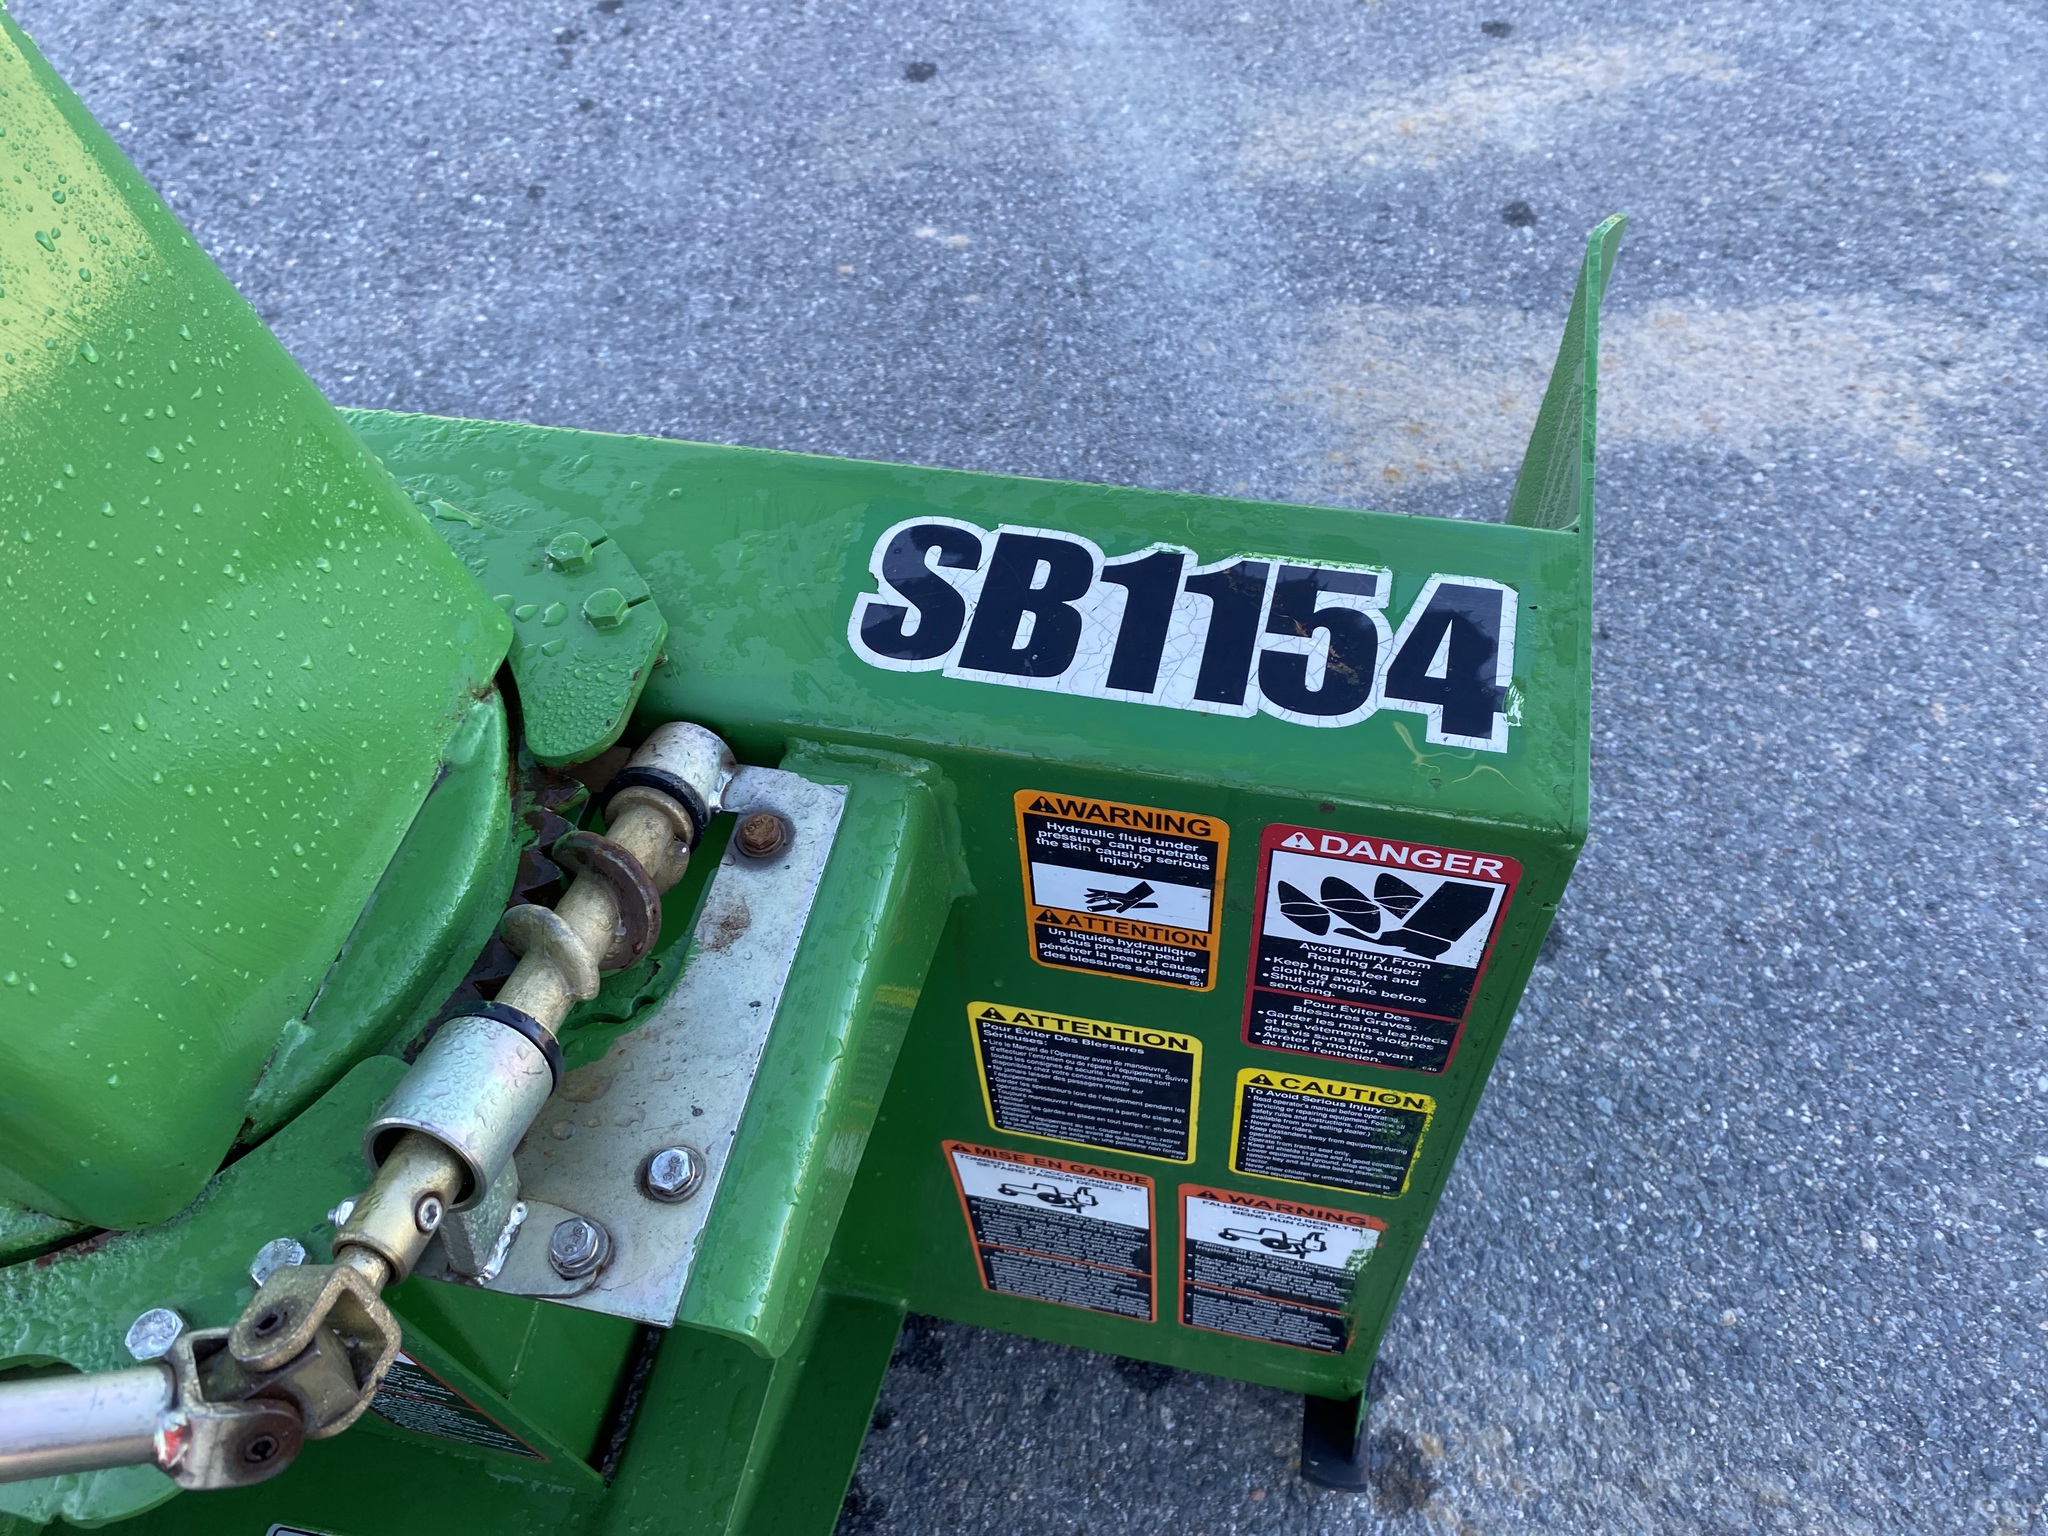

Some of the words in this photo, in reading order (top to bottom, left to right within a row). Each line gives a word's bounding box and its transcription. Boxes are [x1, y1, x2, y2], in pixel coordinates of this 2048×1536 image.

[859, 523, 1509, 742] SB1154
[1056, 798, 1211, 837] WARNING
[1038, 831, 1101, 846] pressure
[1108, 842, 1134, 850] can
[1138, 845, 1208, 863] penetrate
[1046, 821, 1114, 840] Hydraulic
[1118, 833, 1151, 844] fluid
[1155, 838, 1198, 851] under
[1035, 837, 1058, 847] the
[1061, 841, 1091, 852] skin
[1095, 846, 1151, 863] causing
[1155, 856, 1210, 870] serious
[1099, 855, 1143, 869] injury.
[1319, 835, 1505, 878] DANGER
[1048, 927, 1066, 936] Un
[1069, 931, 1114, 945] liquide
[1117, 938, 1196, 958] hydraulique
[1065, 914, 1207, 947] ATTENTION
[1039, 941, 1092, 956] pénétrer
[1110, 954, 1142, 964] peau
[1145, 958, 1158, 966] et
[1161, 962, 1206, 973] causer
[1043, 950, 1066, 959] des
[1069, 954, 1131, 969] blessures
[1135, 964, 1200, 980] sérieuses.
[1059, 938, 1091, 947] sous
[1094, 942, 1151, 958] pression
[1155, 952, 1184, 963] peut
[1299, 943, 1341, 955] Avoid
[1344, 950, 1388, 964] Injury
[1391, 957, 1431, 969] From
[1306, 953, 1368, 969] Rotating
[1371, 962, 1422, 977] Auger:
[1271, 965, 1329, 981] clothing
[1332, 975, 1373, 988] away.
[1273, 956, 1309, 970] Keep
[1391, 975, 1420, 986] and
[1269, 980, 1335, 997] servicing.
[1270, 972, 1302, 983] Shut
[1305, 978, 1325, 987] off
[1328, 981, 1377, 997] engine
[1380, 990, 1427, 1003] before
[1303, 999, 1336, 1010] Pour
[1383, 1012, 1410, 1022] Des
[1363, 1017, 1417, 1031] Graves:
[1010, 1011, 1188, 1050] ATTENTION
[1263, 1024, 1288, 1033] des
[1290, 1029, 1310, 1037] vis
[1348, 1038, 1370, 1047] fin.
[1265, 1010, 1312, 1023] Garder
[1315, 1018, 1335, 1026] les
[1338, 1022, 1383, 1035] mains,
[1386, 1029, 1407, 1038] les
[1409, 1033, 1448, 1046] pieds
[1281, 1020, 1300, 1028] les
[1303, 1023, 1373, 1040] vêtements
[1375, 1035, 1434, 1051] éloignés
[1261, 1038, 1277, 1046] de
[1281, 1042, 1310, 1051] faire
[1313, 1047, 1382, 1063] l'entretien.
[1262, 1031, 1308, 1044] Arrêter
[1326, 1042, 1374, 1054] moteur
[1376, 1050, 1413, 1061] avant
[1279, 1077, 1425, 1109] CAUTION
[975, 1147, 1026, 1163] MISE
[1033, 1157, 1062, 1169] EN
[1069, 1164, 1147, 1184] GARDE
[1202, 1200, 1249, 1212] FALLING
[1304, 1218, 1348, 1229] RESULT
[1228, 1194, 1367, 1225] WARNING
[1232, 1210, 1267, 1220] BEING
[1269, 1217, 1294, 1225] RUN
